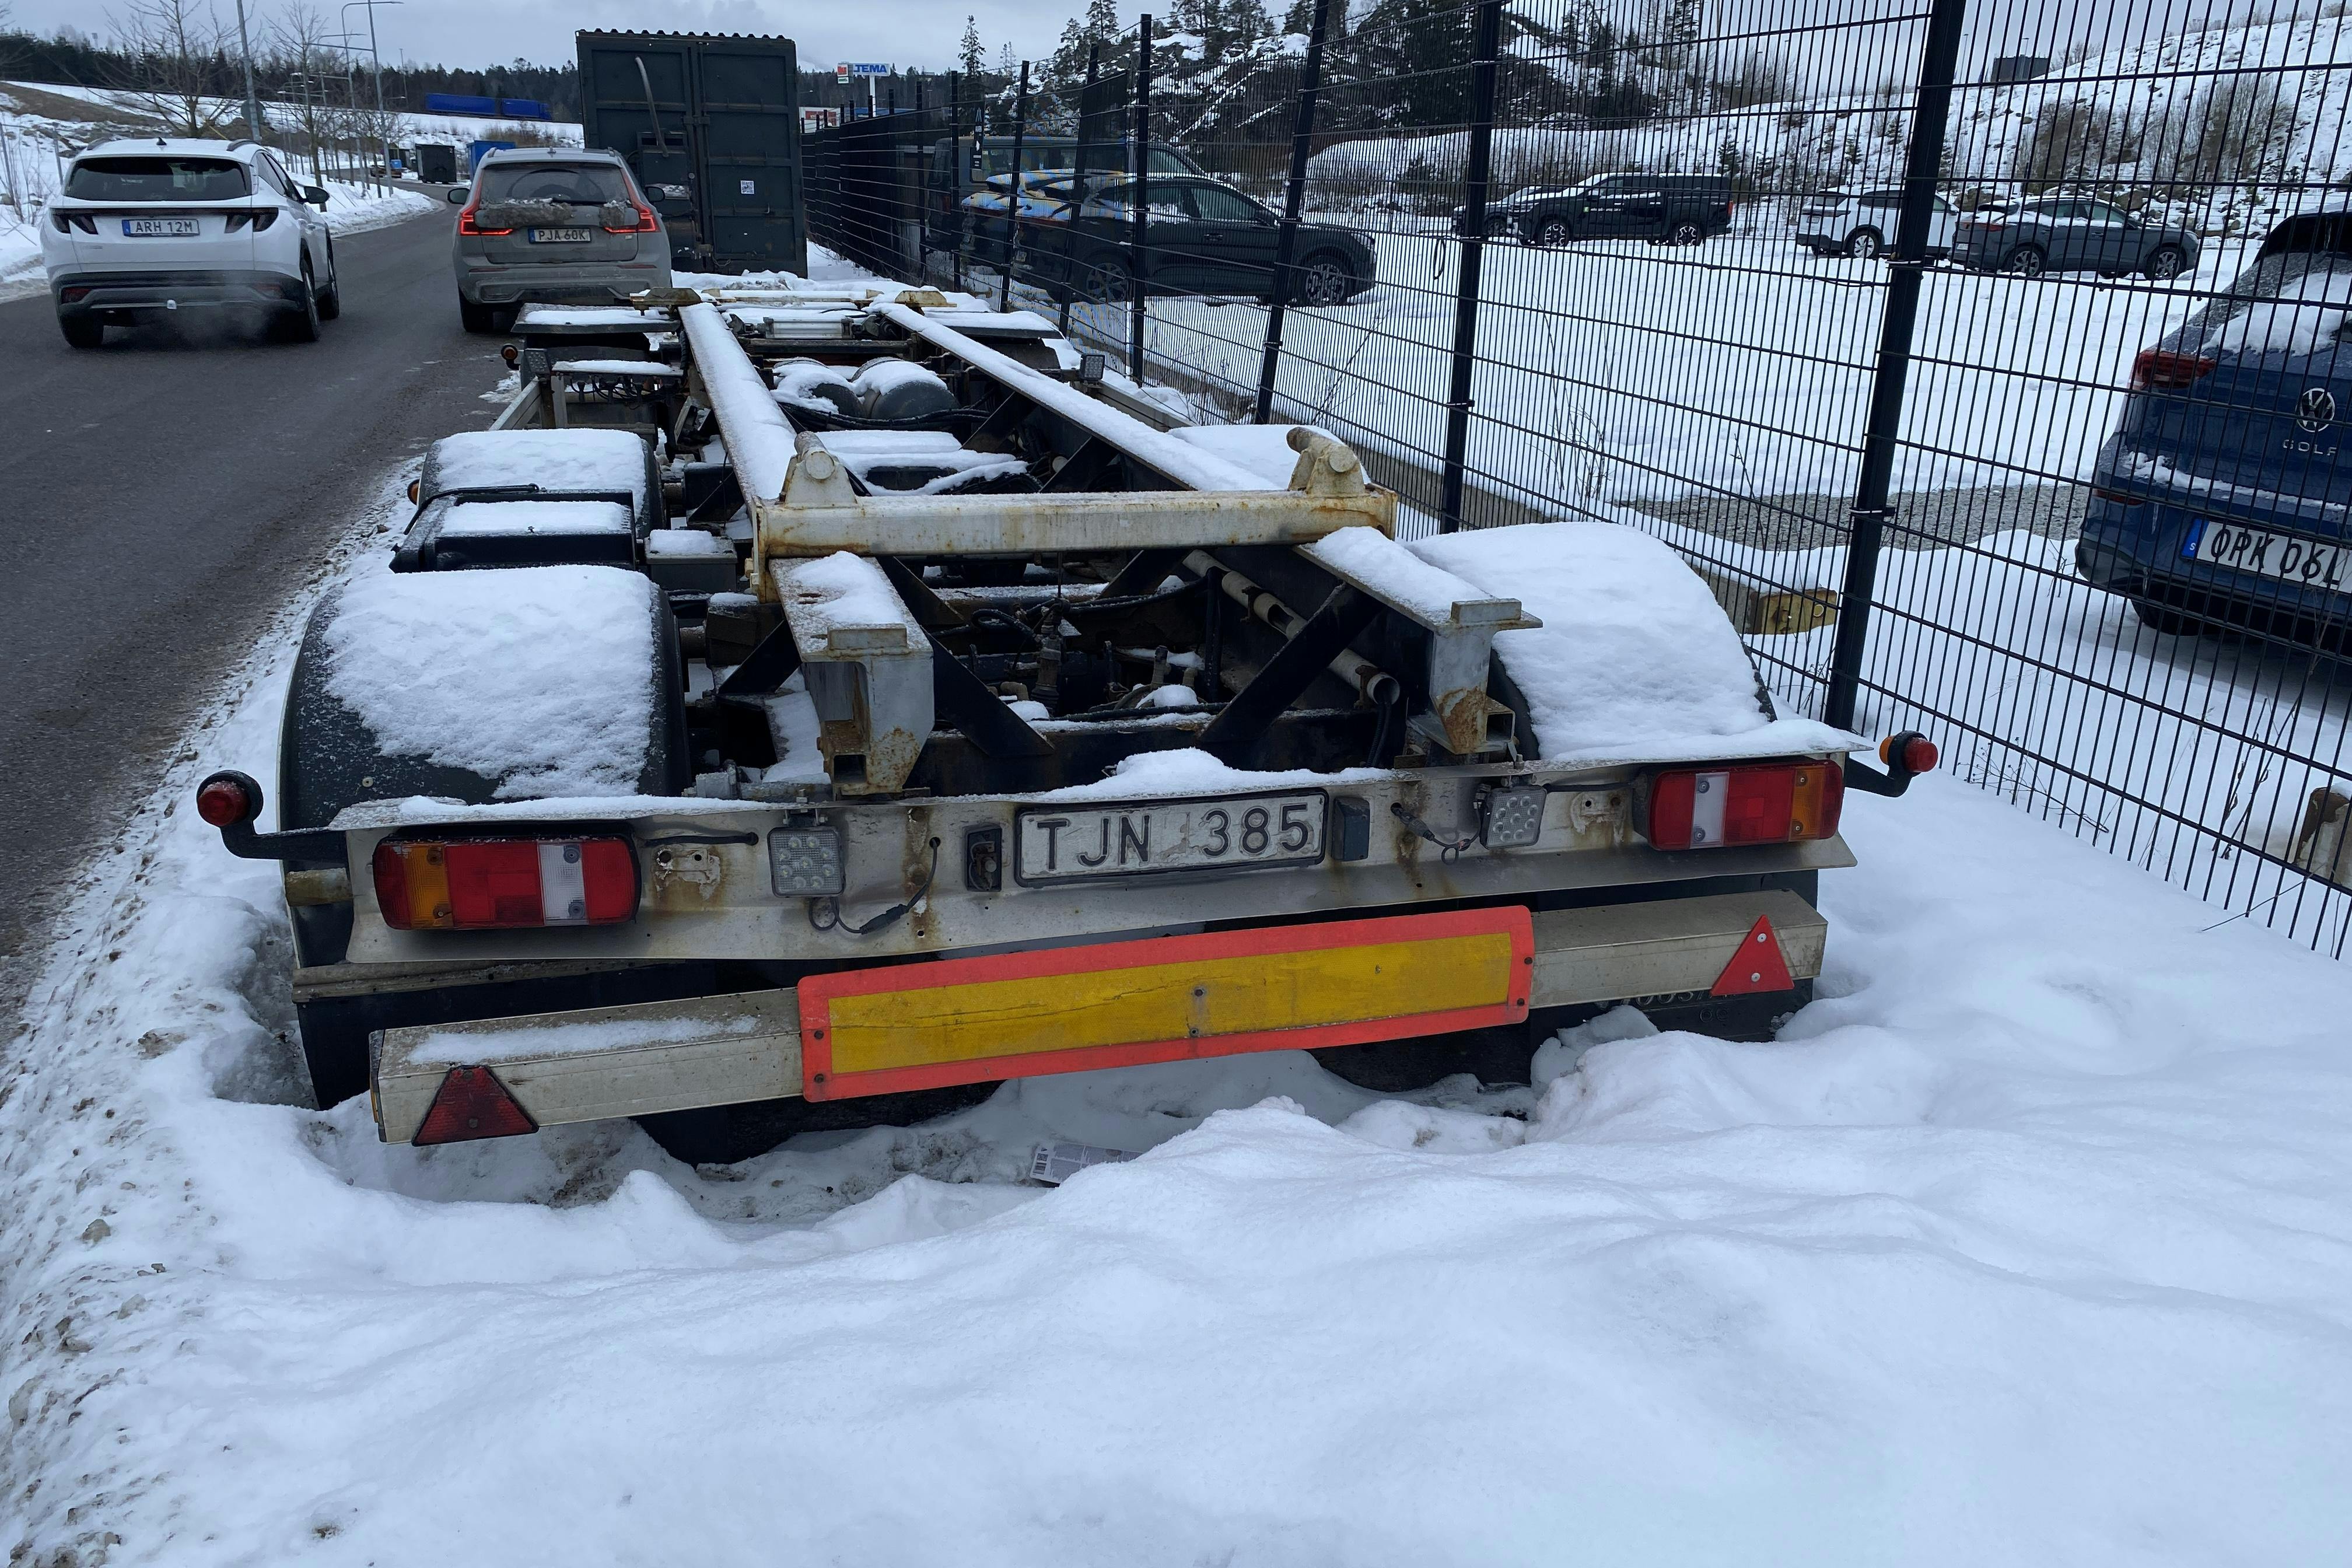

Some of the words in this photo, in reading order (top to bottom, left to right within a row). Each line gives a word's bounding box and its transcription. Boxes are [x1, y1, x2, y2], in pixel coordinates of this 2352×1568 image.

[136, 221, 162, 232] ARH
[167, 221, 192, 232] 12M
[538, 230, 561, 240] PJA
[564, 230, 586, 240] 60K
[2283, 439, 2337, 456] GOLF
[2189, 542, 2196, 551] S
[1037, 814, 1151, 871] TJN
[1202, 804, 1310, 858] 385
